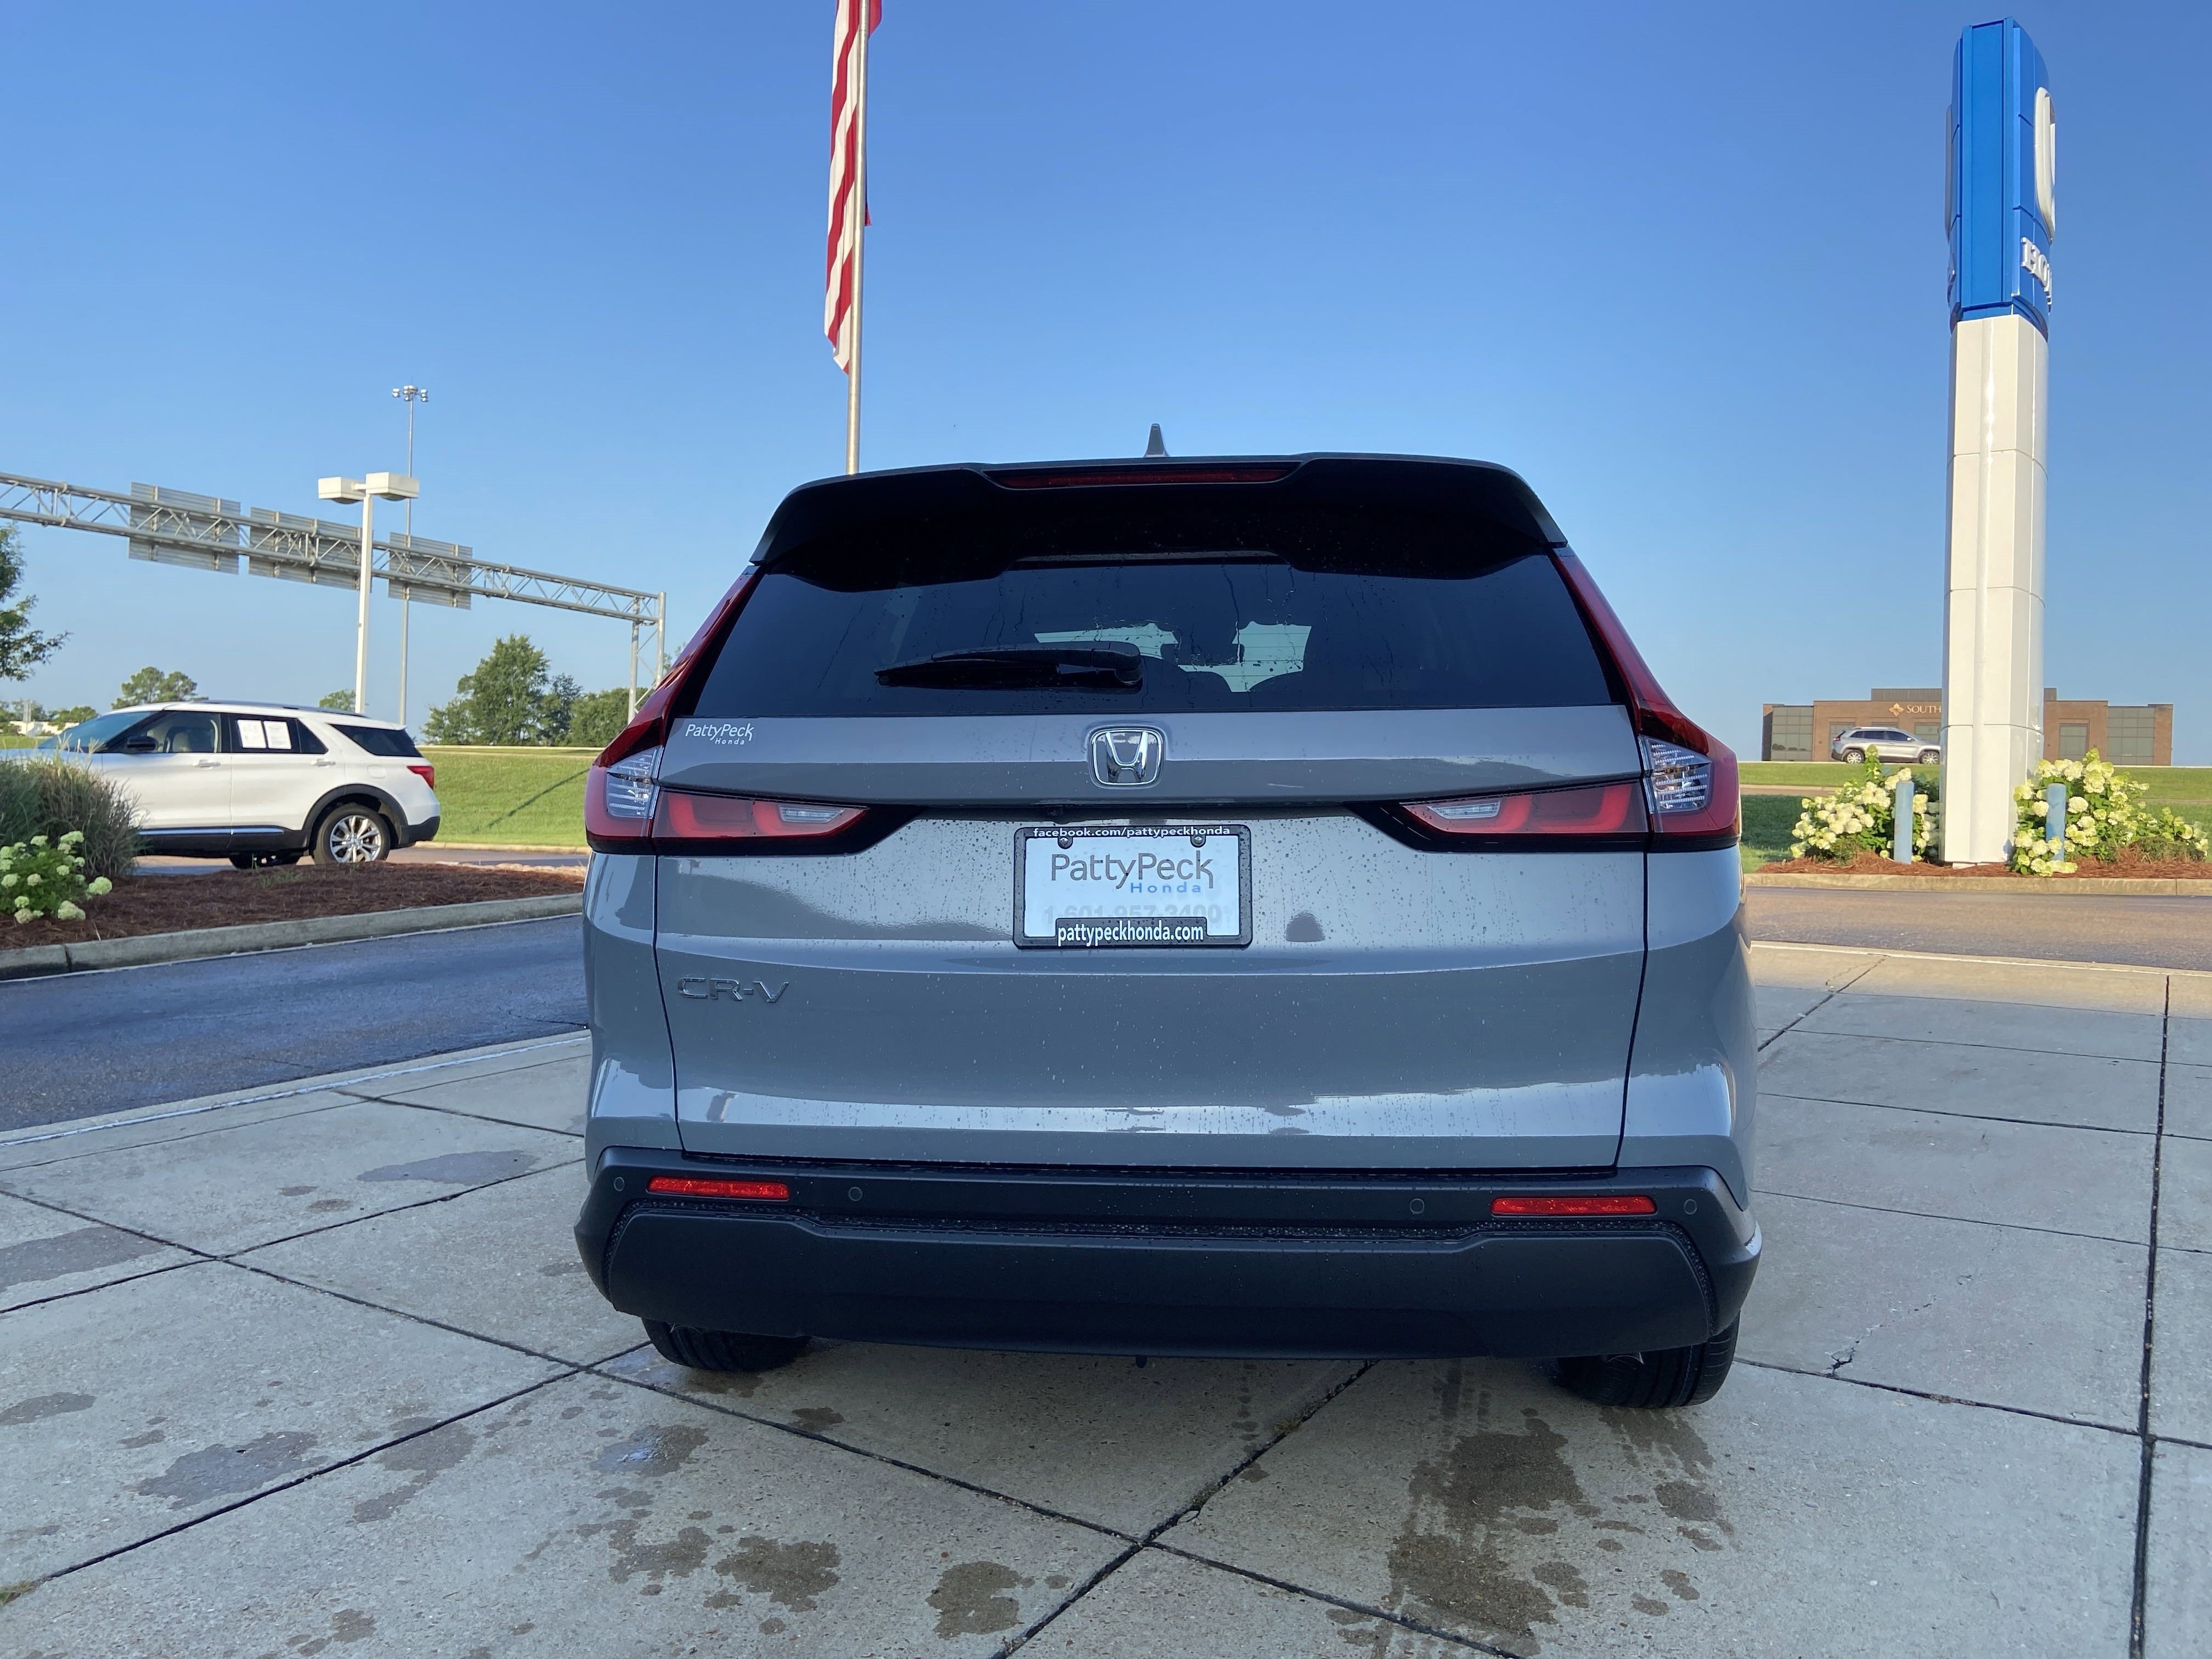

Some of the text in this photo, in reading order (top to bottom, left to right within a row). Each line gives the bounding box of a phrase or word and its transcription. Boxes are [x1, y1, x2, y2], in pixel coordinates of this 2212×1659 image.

[1906, 704, 1941, 713] SOUTH
[685, 723, 754, 741] PattyPeck
[1033, 826, 1230, 838] facebook.com/pattypeckhonda
[1051, 850, 1214, 889] PattyPeck
[1130, 882, 1201, 893] Honda
[1058, 919, 1204, 946] pattypeckhonda.com
[677, 977, 790, 1003] CR-V
